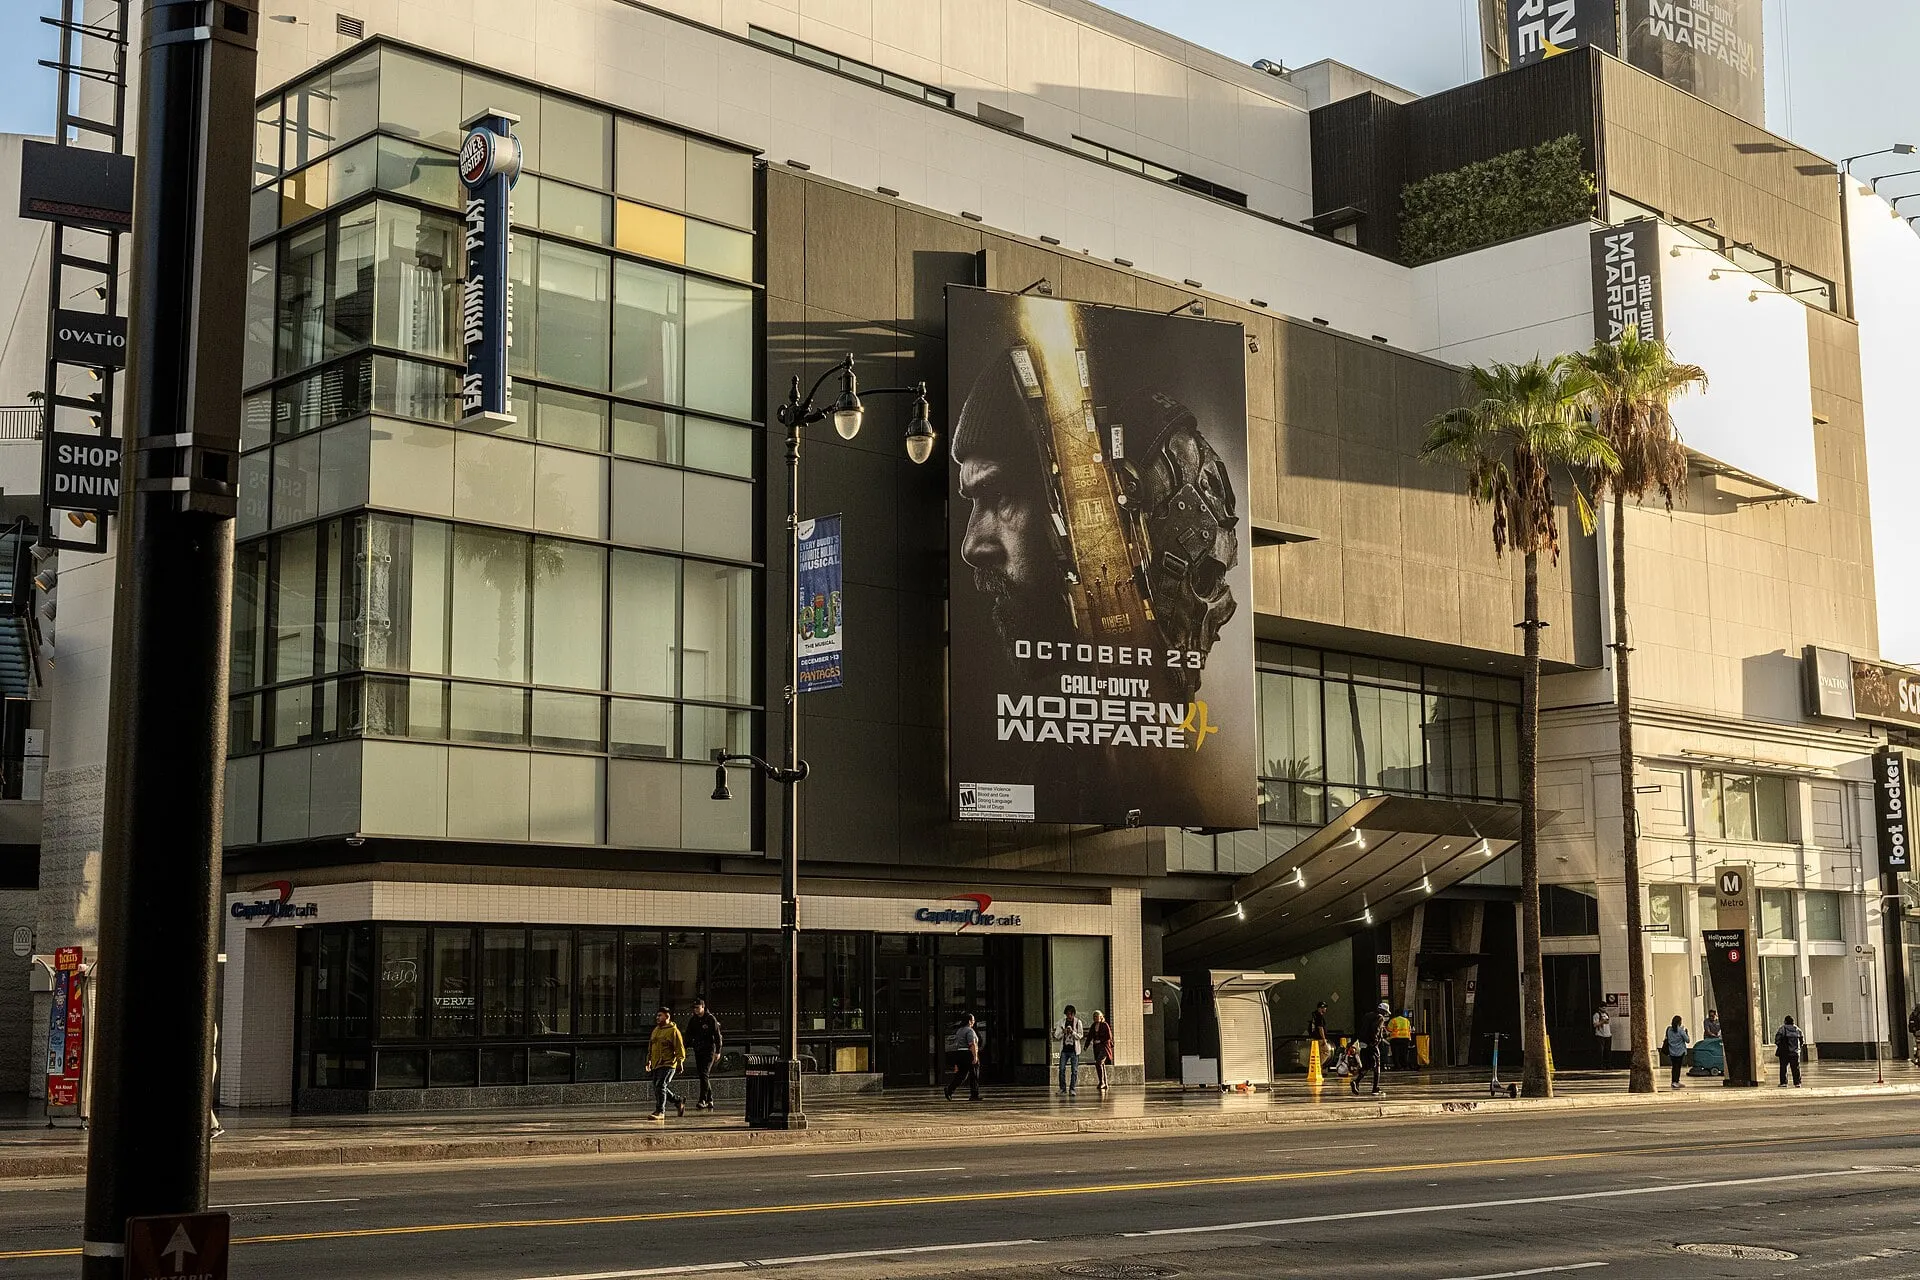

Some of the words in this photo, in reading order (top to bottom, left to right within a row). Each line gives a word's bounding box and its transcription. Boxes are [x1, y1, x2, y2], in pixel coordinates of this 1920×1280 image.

[1690, 0, 1711, 17] CALL
[1714, 4, 1735, 28] DUTY
[1649, 0, 1751, 61] MODERN
[1649, 17, 1750, 78] WARFARE
[460, 138, 478, 165] DAVE
[466, 198, 486, 251] PLAY
[1619, 231, 1640, 342] MODE
[1638, 275, 1652, 306] CALL
[464, 274, 485, 346] DRINK
[58, 328, 126, 348] OVATIO
[463, 373, 483, 412] EAT
[58, 444, 122, 467] SHOP
[799, 540, 816, 551] EVERY
[799, 555, 840, 572] MUSICAL
[814, 640, 835, 648] MUSICAL
[1015, 640, 1153, 666] OCTOBER
[1166, 649, 1201, 669] 23
[801, 656, 830, 666] DECEMBER
[799, 666, 841, 682] PANTAGES
[1060, 674, 1098, 696] CALL
[1097, 679, 1108, 689] OF
[1108, 677, 1150, 698] DUTY
[997, 693, 1184, 725] MODERN
[997, 718, 1185, 749] WARFARE
[960, 790, 975, 806] M
[1884, 757, 1902, 820] Locker
[1888, 824, 1906, 865] Foot
[1723, 875, 1739, 892] M
[1720, 899, 1744, 907] Metro
[998, 914, 1021, 926] café
[1715, 941, 1740, 949] Highland
[1731, 951, 1738, 960] B
[59, 953, 78, 965] TICKETS
[433, 997, 475, 1006] VERVE
